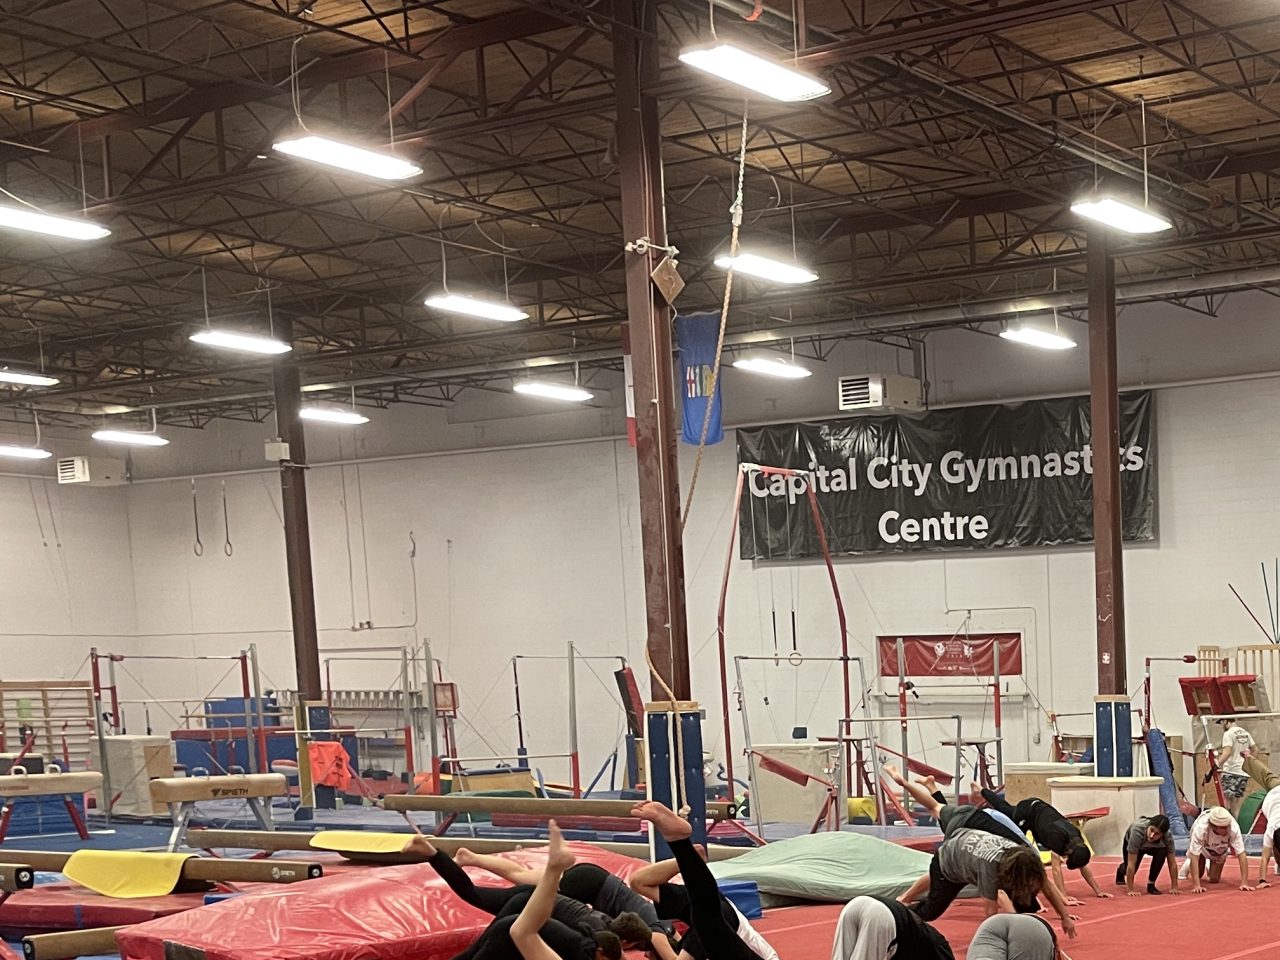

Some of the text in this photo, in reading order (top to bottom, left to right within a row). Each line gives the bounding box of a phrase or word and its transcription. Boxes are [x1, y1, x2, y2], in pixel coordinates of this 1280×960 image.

[750, 444, 1144, 504] Capital City Gymnasts
[878, 510, 989, 544] Centre
[221, 788, 249, 796] SPIETH
